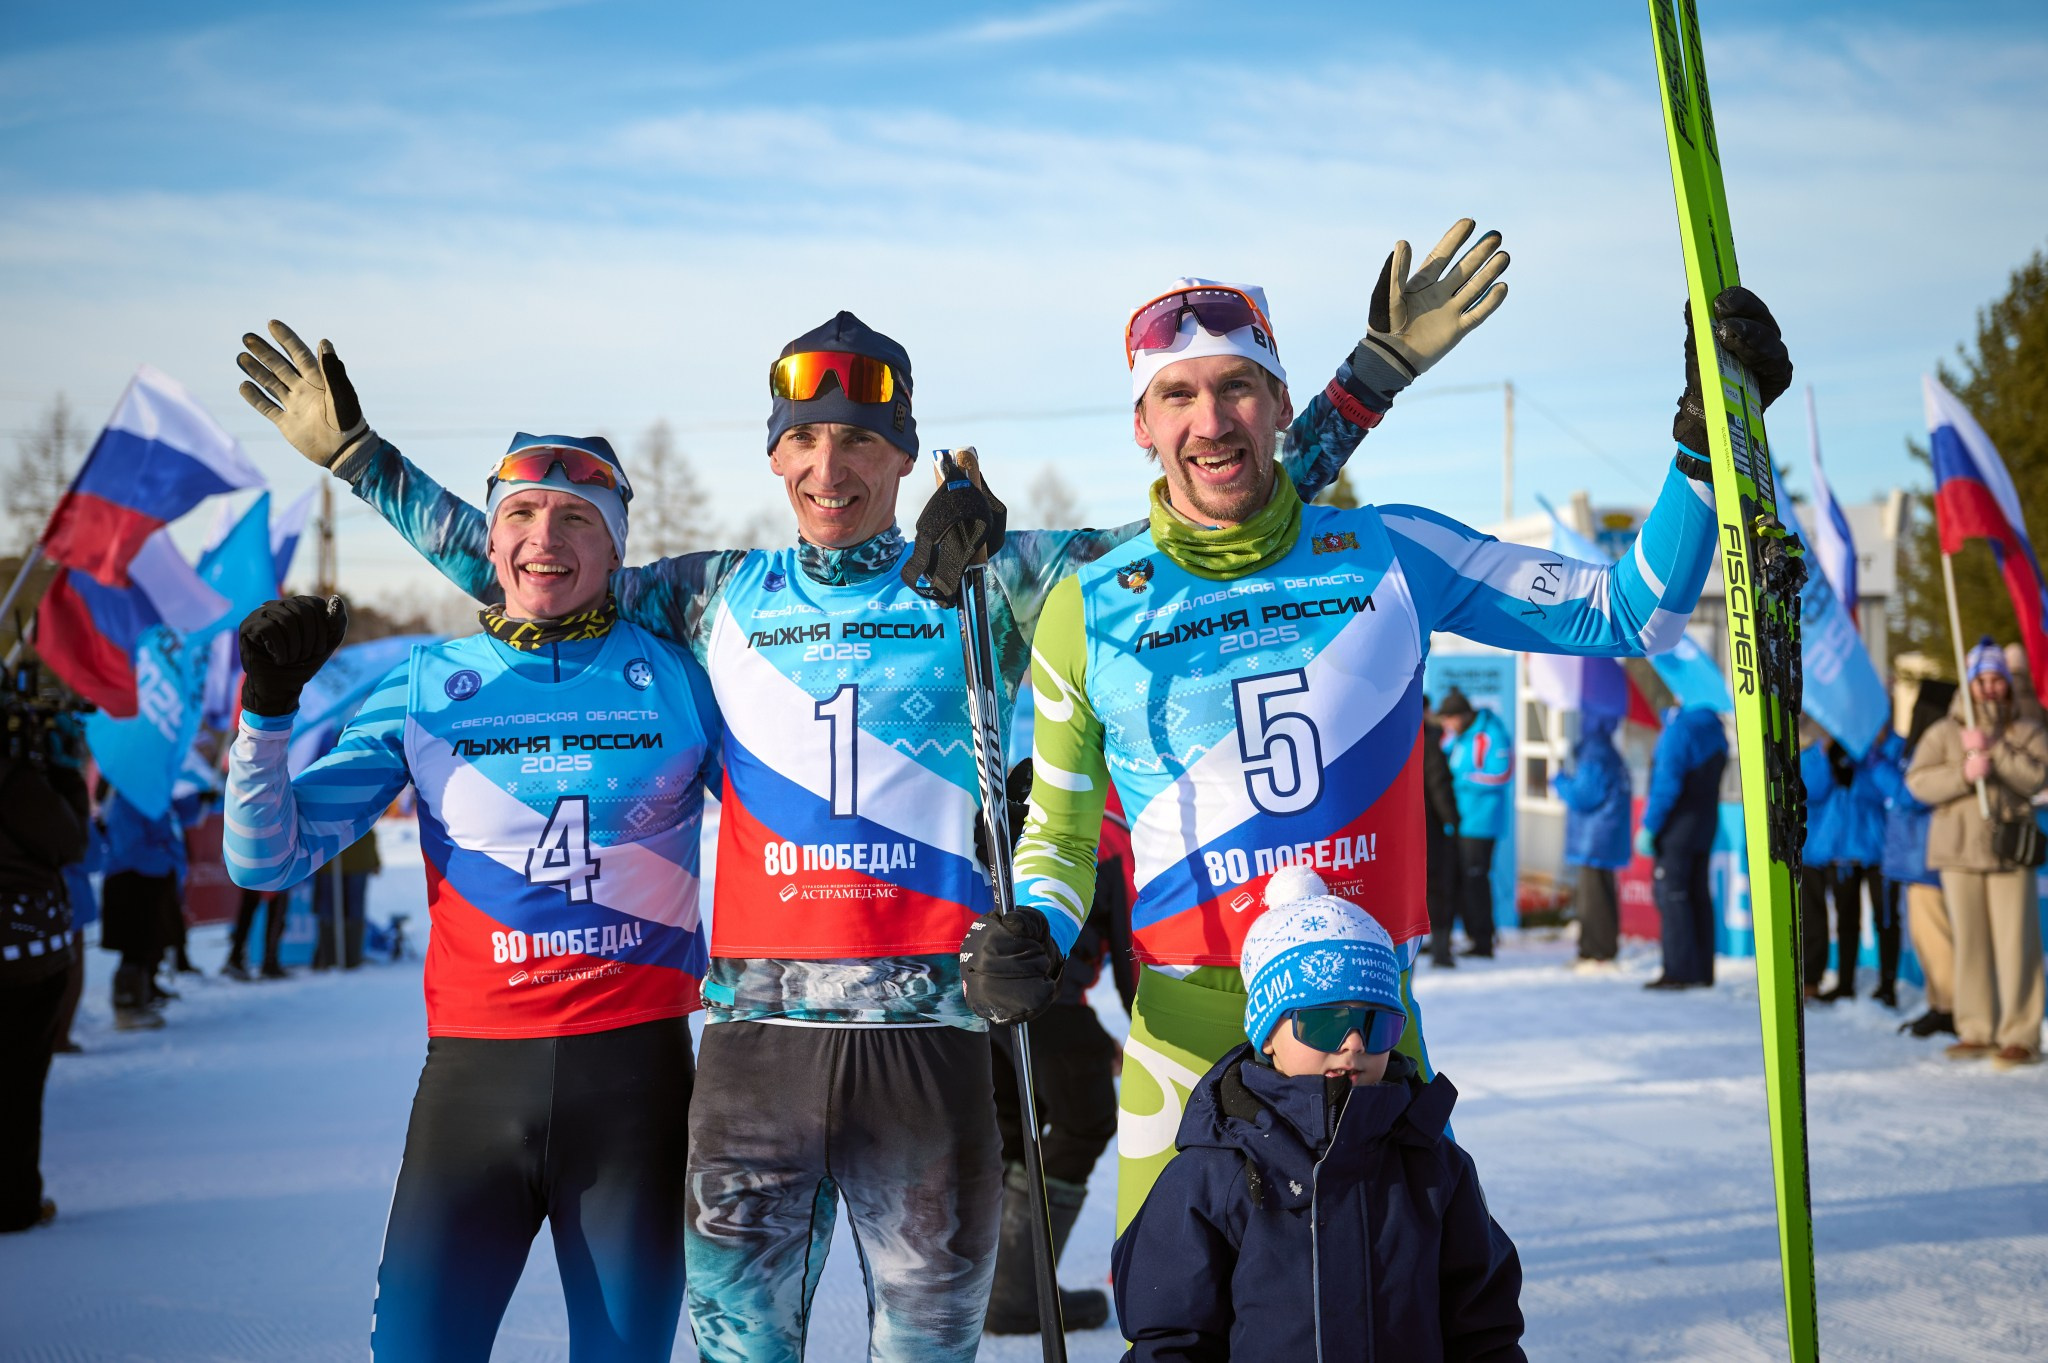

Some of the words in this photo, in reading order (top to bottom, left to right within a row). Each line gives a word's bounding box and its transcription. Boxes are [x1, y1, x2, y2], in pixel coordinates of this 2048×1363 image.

[1135, 582, 1276, 624] СВЕРДЛОВСКАЯ
[1284, 573, 1364, 590] ОБЛАСТЬ
[1521, 553, 1564, 620] УРА
[1135, 609, 1249, 654] ЛЫЖНЯ
[1262, 595, 1376, 623] РОССИИ
[1723, 523, 1755, 696] FISCHER
[747, 622, 831, 649] ЛЫЖНЯ
[842, 622, 945, 639] РОССИИ
[803, 643, 872, 662] 2025
[1219, 624, 1300, 655] 2025
[452, 710, 578, 729] СВЕРДЛОВСКАЯ
[586, 709, 659, 721] ОБЛАСТЬ
[452, 734, 550, 757] ЛЫЖНЯ
[562, 733, 663, 752] РОССИИ
[814, 683, 859, 820] 1
[966, 684, 994, 837] SWIX
[1231, 667, 1325, 818] 5
[521, 755, 592, 774] 2025
[525, 795, 600, 906] 4
[764, 841, 798, 876] 80
[803, 842, 916, 874] ПОБЕДА!
[1203, 848, 1251, 887] 80
[1254, 833, 1377, 876] ПОБЕДА!
[800, 888, 899, 900] АСТРАМЕД-МС
[492, 932, 528, 964] 80
[533, 921, 643, 958] ПОБЕДА!
[531, 965, 626, 985] АСТРАМЕД-МС
